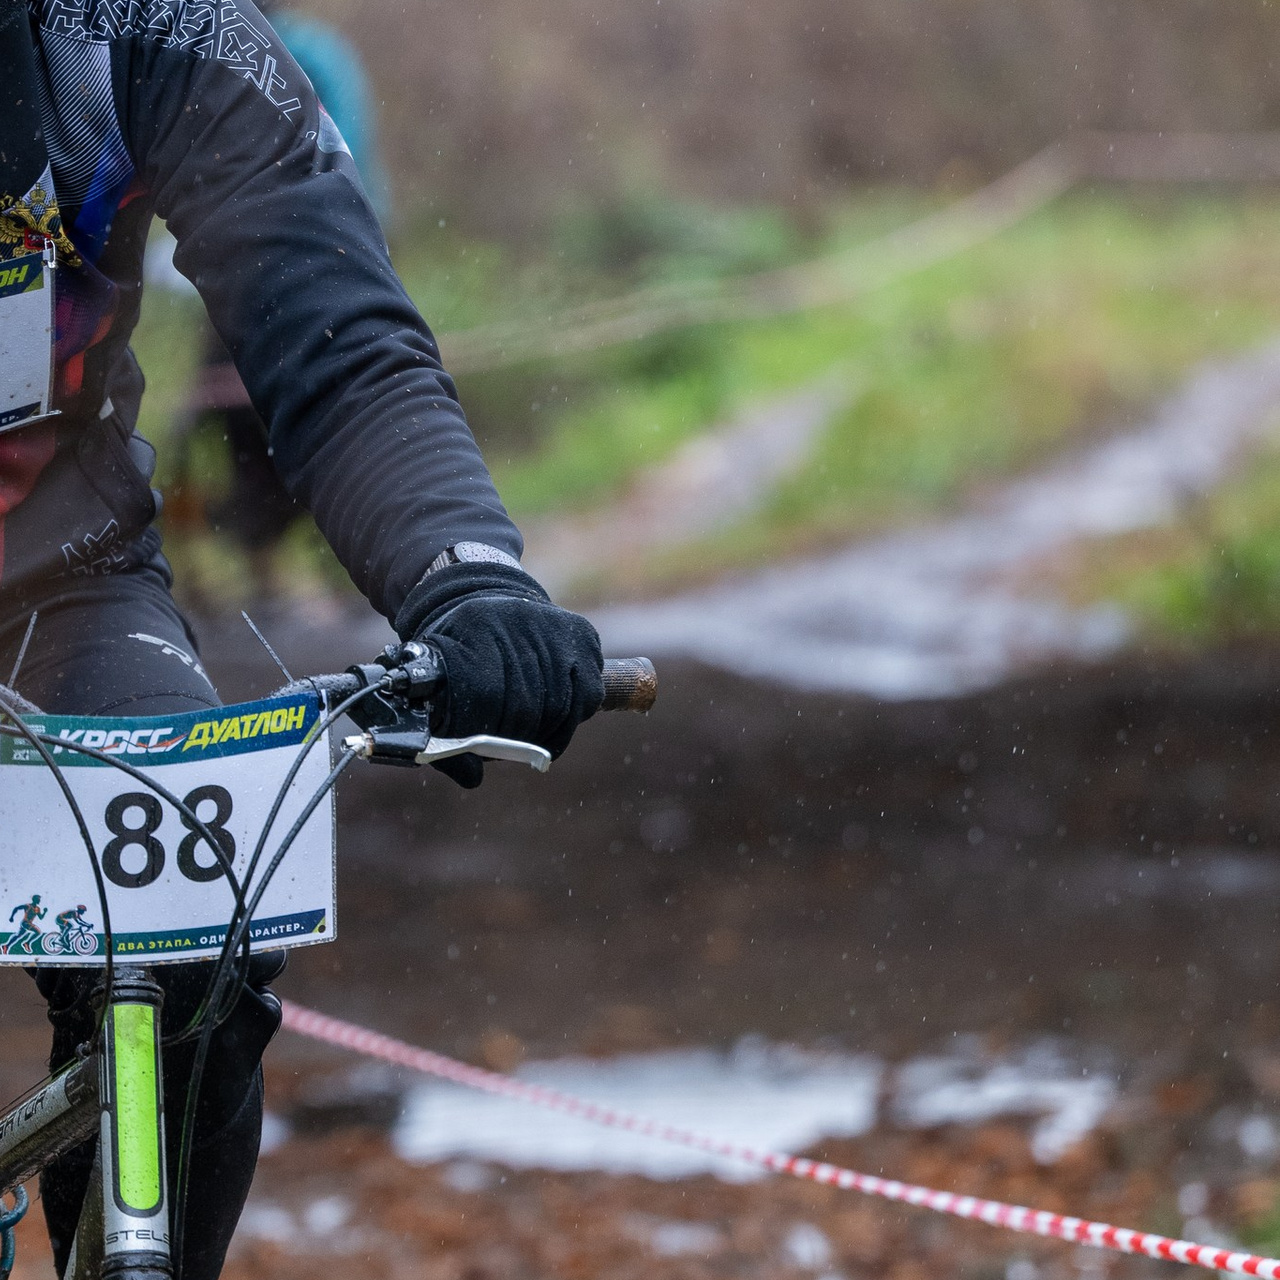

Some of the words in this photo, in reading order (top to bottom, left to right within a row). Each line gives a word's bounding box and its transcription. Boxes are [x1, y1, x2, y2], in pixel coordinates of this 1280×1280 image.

[182, 704, 306, 752] ДУАТЛОН
[101, 784, 236, 889] 88
[117, 942, 145, 952] ДВА
[149, 938, 196, 950] ЭТАПА.
[199, 932, 234, 945] ОДИ
[246, 922, 305, 939] АРАКТЕР.
[106, 1229, 170, 1245] STELS
